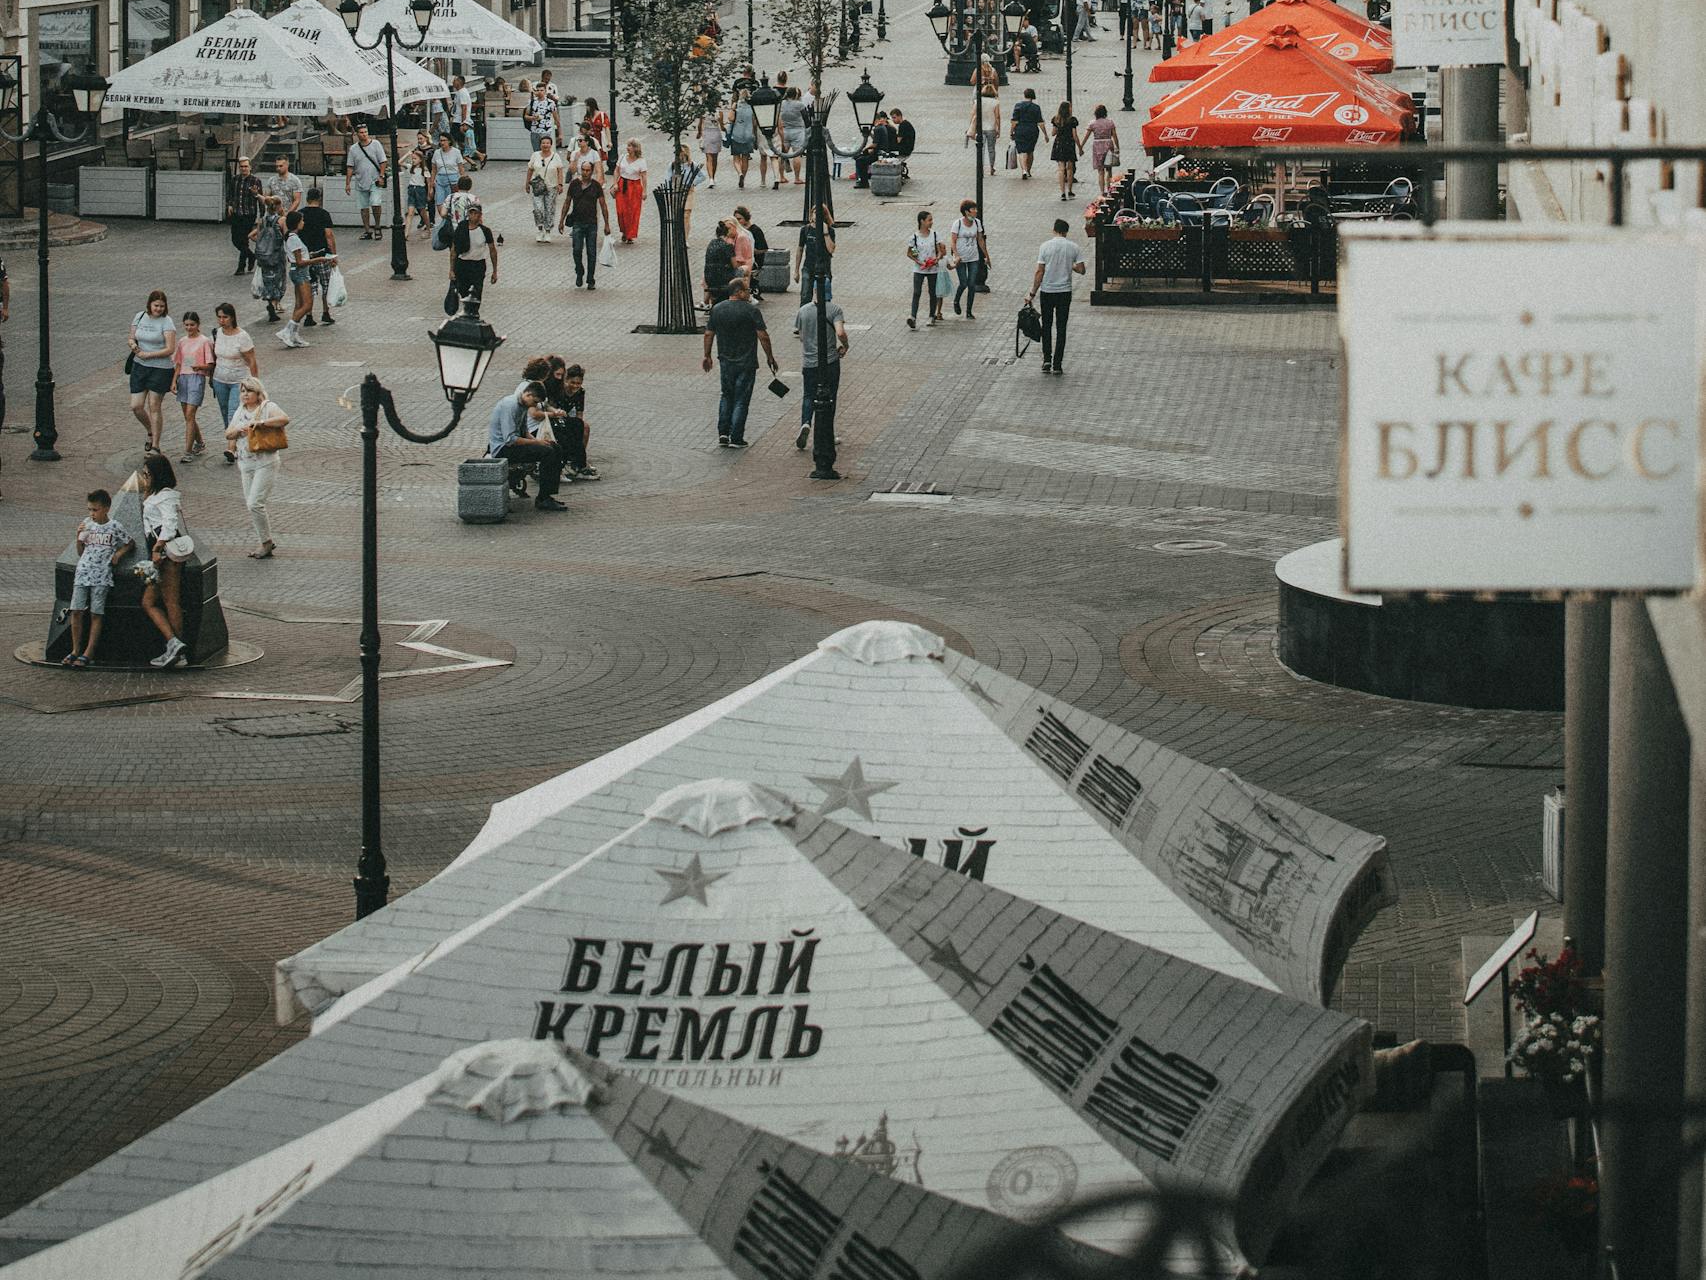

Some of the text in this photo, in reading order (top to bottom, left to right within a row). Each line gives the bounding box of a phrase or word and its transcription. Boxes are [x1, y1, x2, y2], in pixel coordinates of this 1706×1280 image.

[204, 36, 258, 48] БЕЛЫЙ
[196, 48, 257, 61] КРЕМЛЬ
[472, 47, 522, 56] БЕЛЫЙ КРЕМЛЬ
[105, 93, 165, 105] БЕЛЫЙ КРЕМЛЬ
[183, 96, 241, 108] БЕЛЫЙ КРЕМЛЬ
[259, 99, 317, 110] БЕЛЫЙ КРЕМЛЬ
[1234, 94, 1304, 110] Bud
[1167, 127, 1188, 137] Bud
[1260, 127, 1281, 137] Bud
[1353, 130, 1375, 140] Bud
[1435, 350, 1616, 398] КАФЕ
[1376, 417, 1682, 481] БЛИСС
[1024, 705, 1091, 783] БЕЛЫЙ
[559, 927, 821, 997] БЕЛЫЙ
[533, 1000, 823, 1061] КРЕМЛЬ
